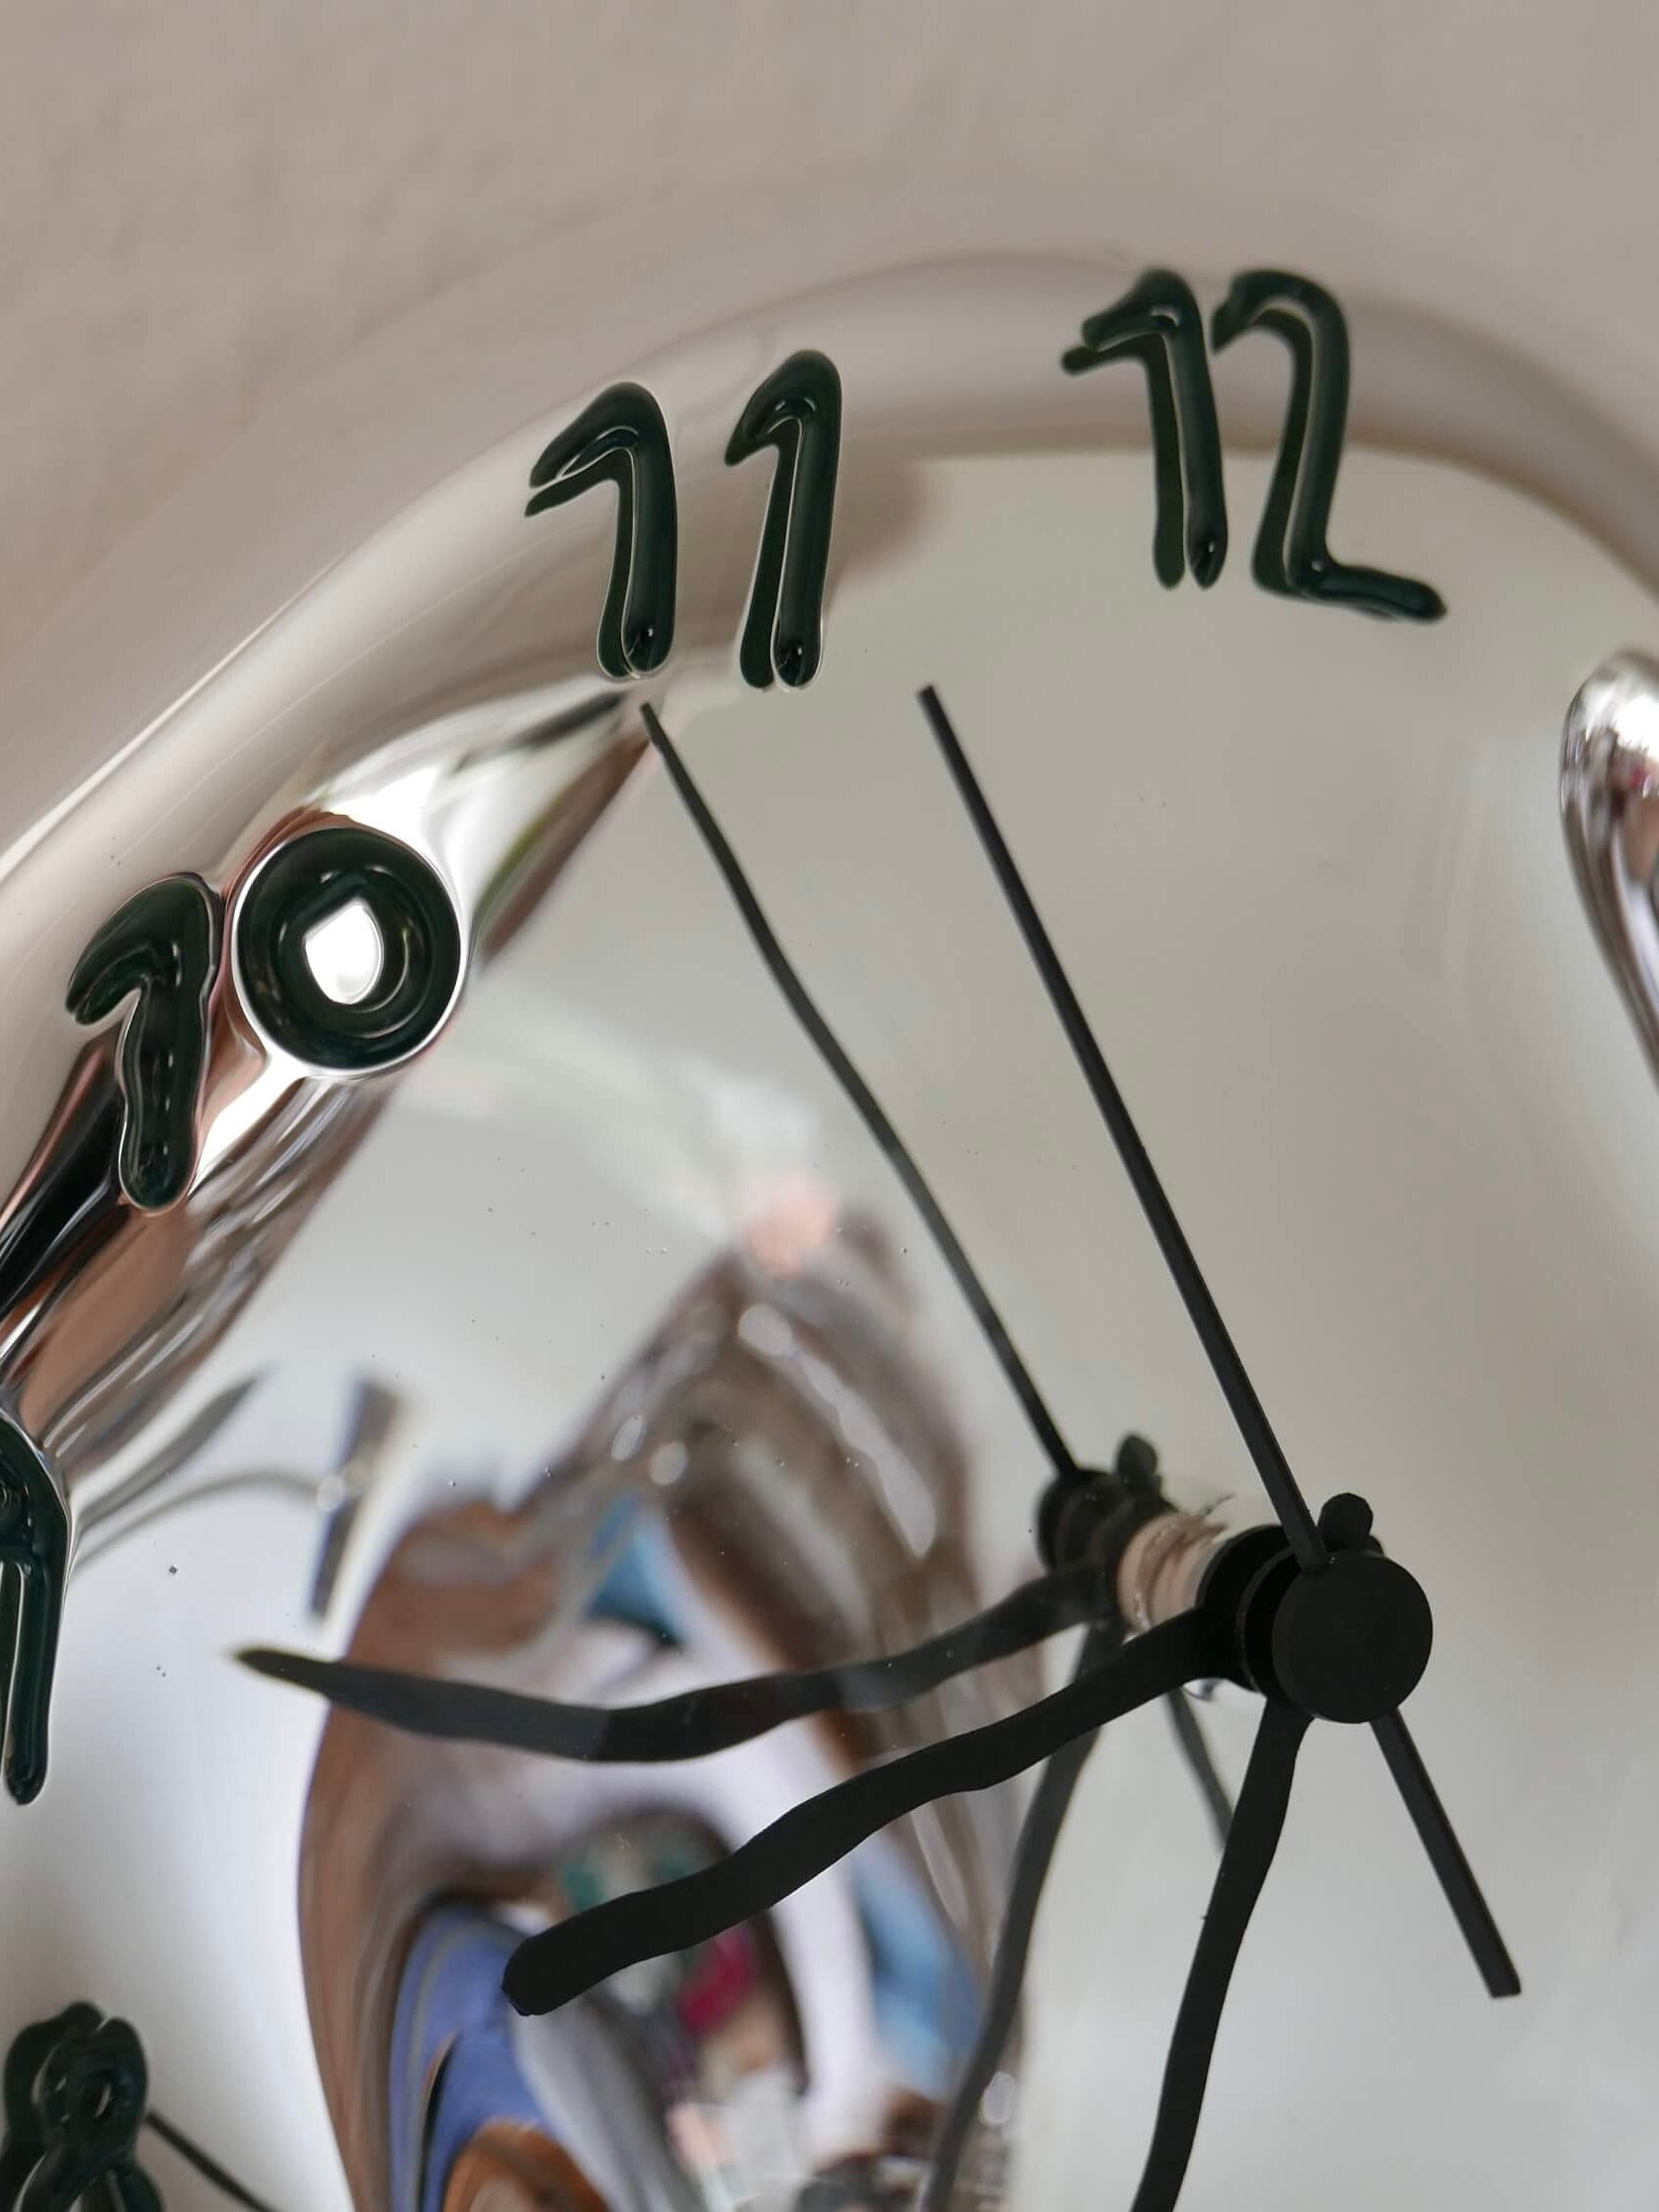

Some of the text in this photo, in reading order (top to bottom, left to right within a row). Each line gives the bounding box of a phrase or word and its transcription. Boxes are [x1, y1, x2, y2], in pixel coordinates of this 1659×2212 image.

[525, 350, 841, 689] 11
[1064, 269, 1447, 623] 12
[66, 828, 460, 1210] 10
